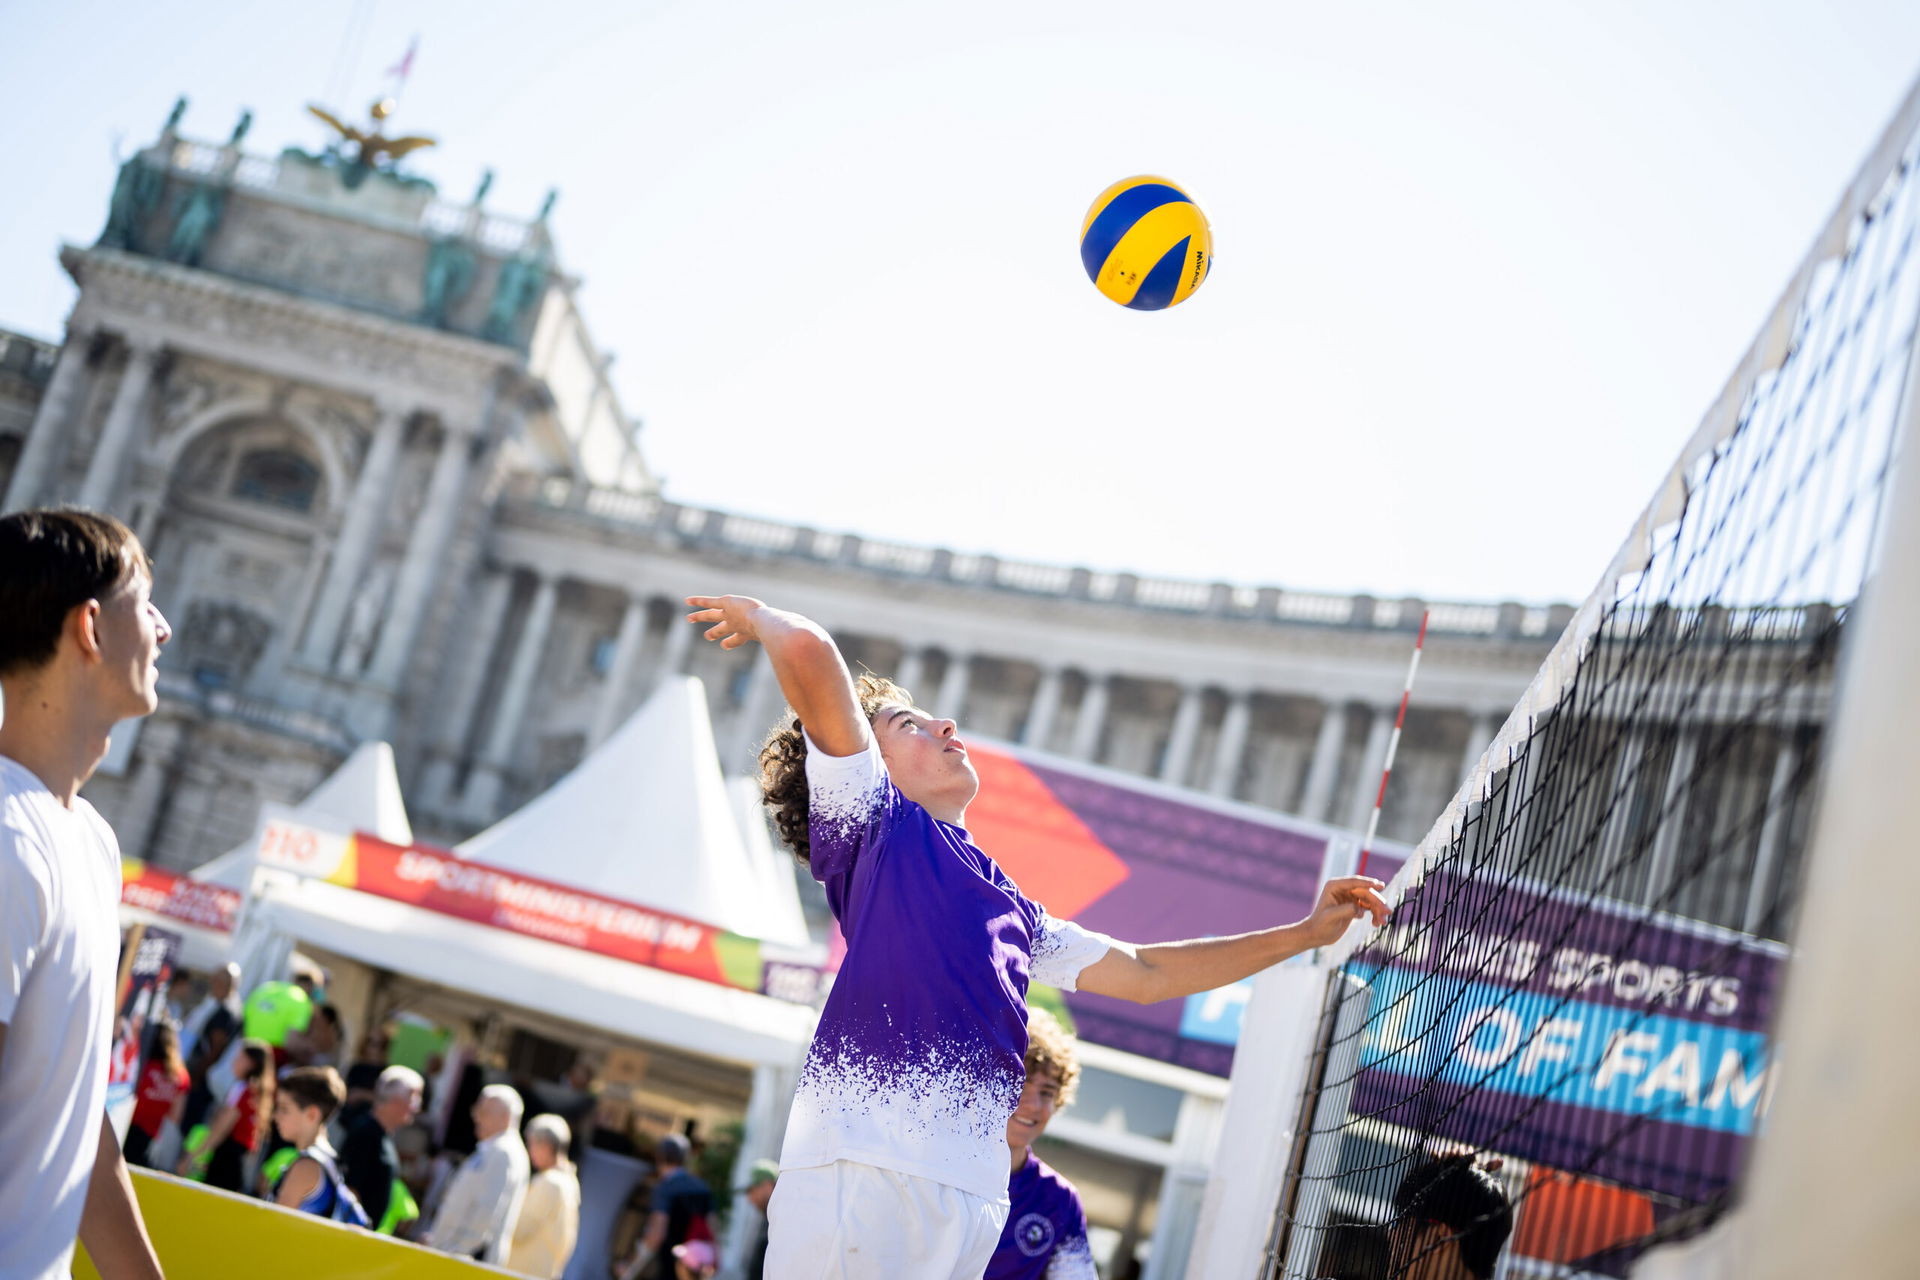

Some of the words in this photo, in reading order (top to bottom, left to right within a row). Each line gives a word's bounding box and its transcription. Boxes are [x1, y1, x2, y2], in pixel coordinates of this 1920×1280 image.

[1547, 948, 1741, 1016] SPORTS
[1456, 1003, 1583, 1078] OF
[1591, 1027, 1783, 1118] FAM
